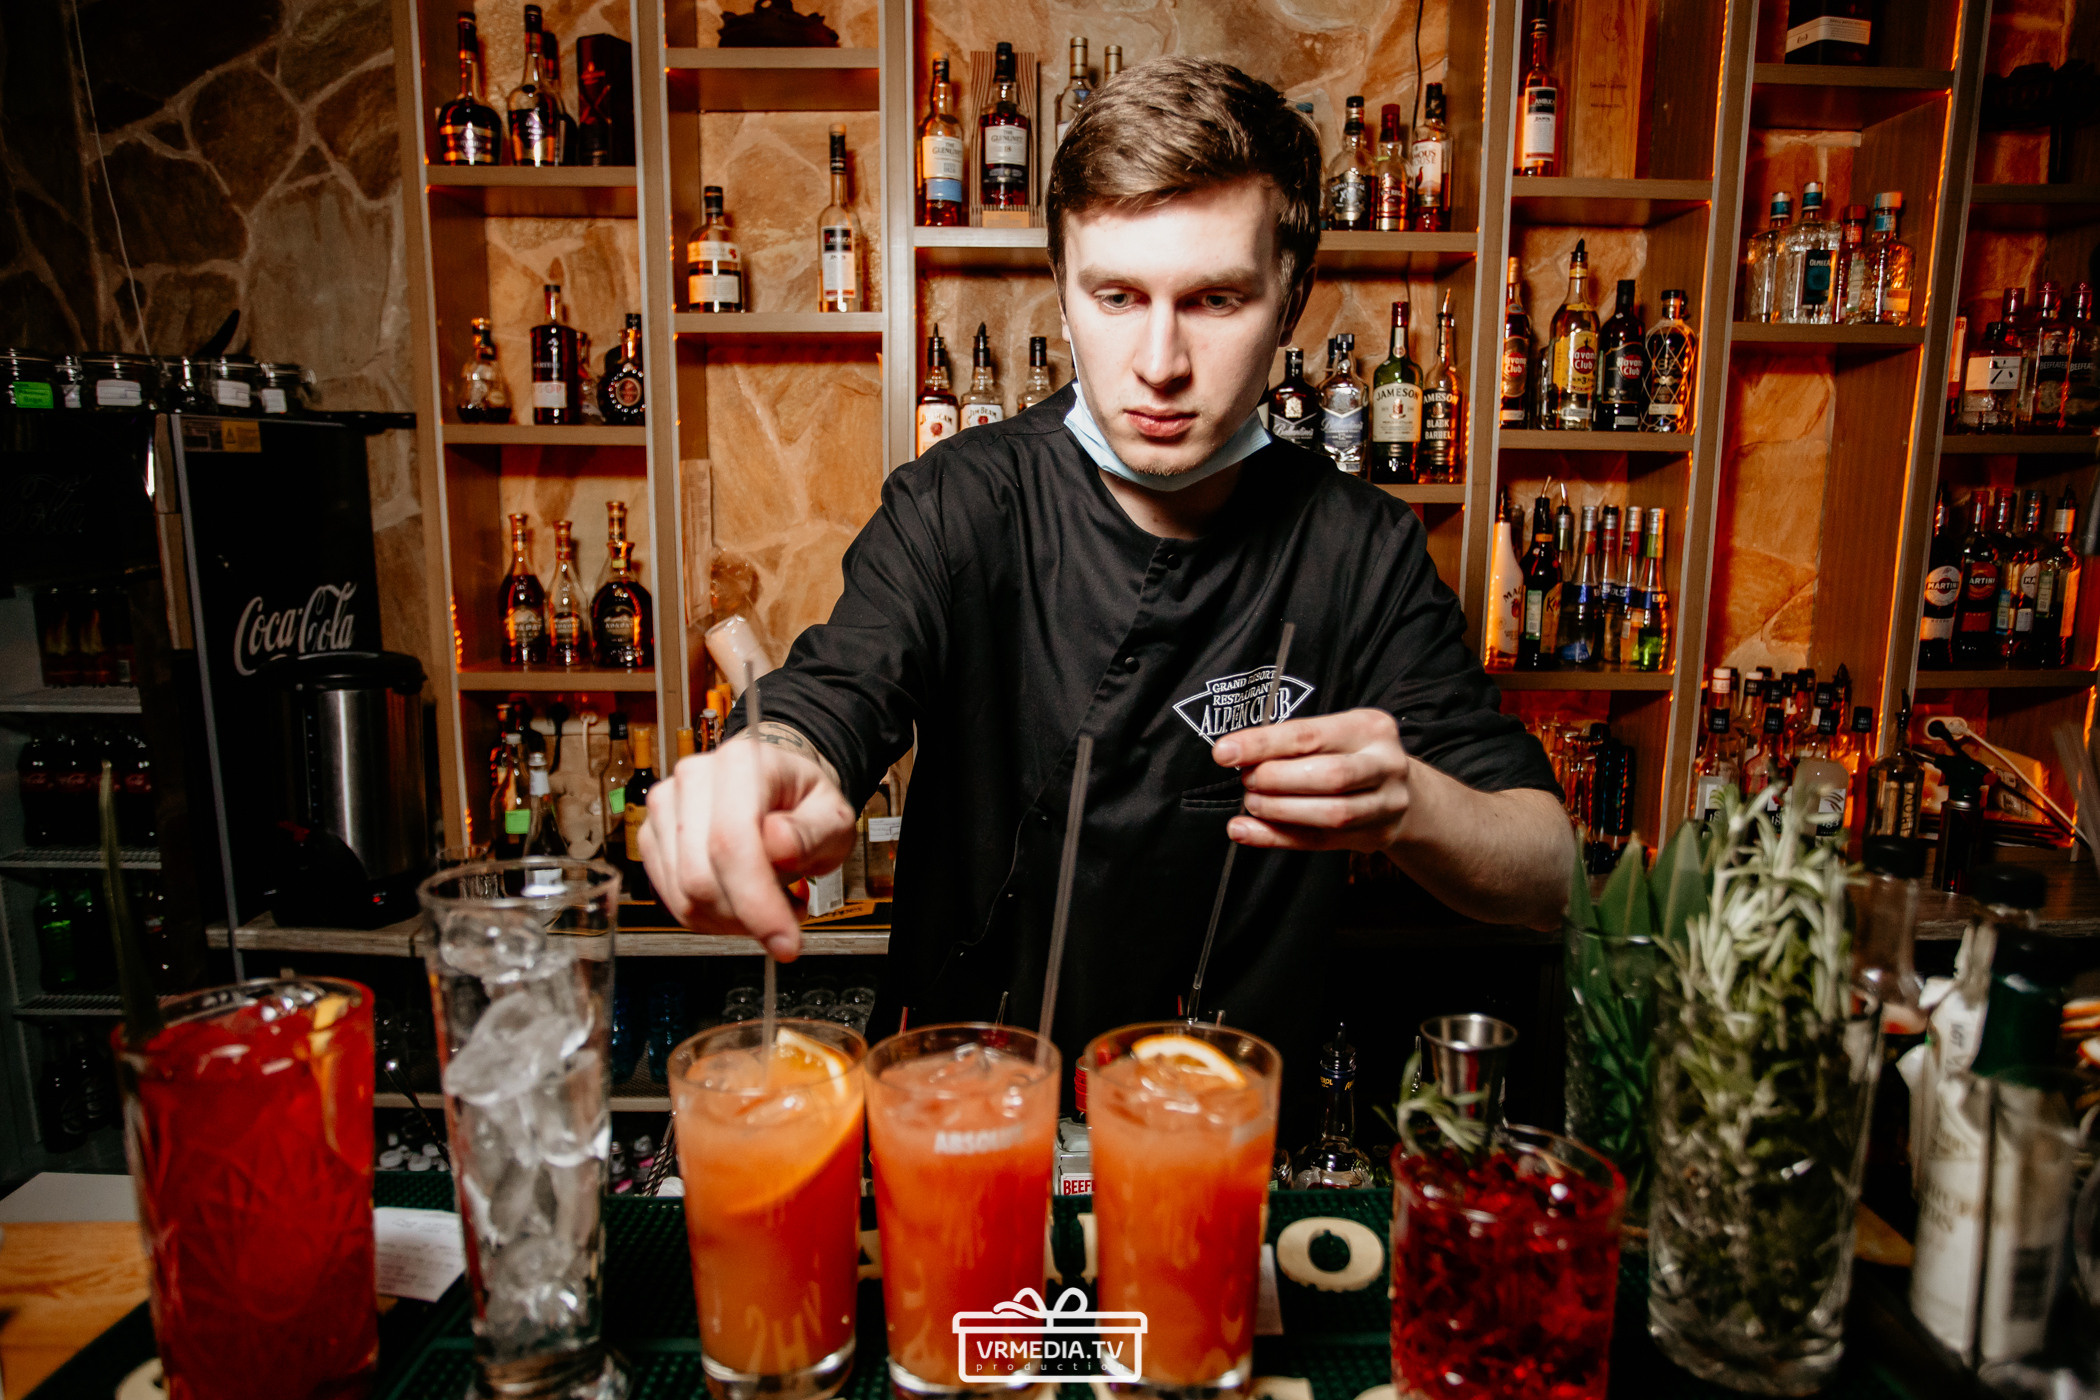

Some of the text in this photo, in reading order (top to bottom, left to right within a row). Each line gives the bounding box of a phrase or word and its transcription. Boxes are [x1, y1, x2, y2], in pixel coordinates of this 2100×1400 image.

[1574, 359, 1593, 370] Club
[1623, 366, 1640, 376] Club
[1376, 387, 1420, 401] JAMESON
[233, 580, 357, 677] Coca-Cola
[1212, 670, 1276, 694] GRAND RESORT
[1199, 700, 1251, 737] ALPEN
